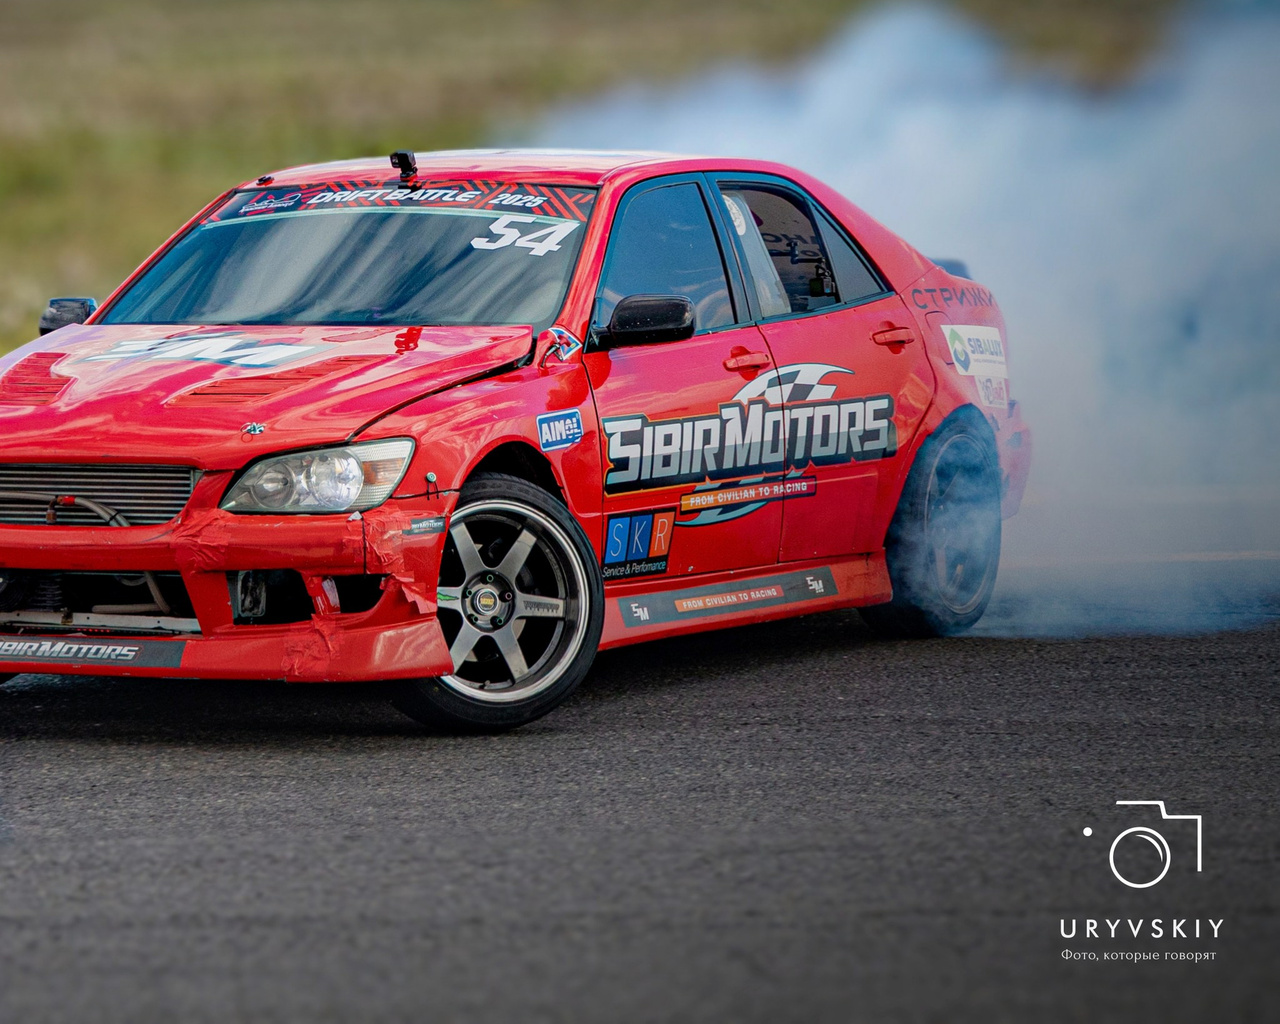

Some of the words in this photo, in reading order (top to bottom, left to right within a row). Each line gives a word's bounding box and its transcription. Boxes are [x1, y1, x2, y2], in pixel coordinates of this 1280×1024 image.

[306, 189, 389, 205] DRIFT
[383, 188, 481, 202] BATTLE
[488, 193, 548, 207] 2025
[470, 215, 581, 257] 54
[967, 337, 1004, 358] SIBALUX
[541, 417, 581, 444] AIMOL
[690, 494, 714, 507] FROM
[717, 489, 755, 502] CIVILIAN
[759, 487, 770, 497] TO
[773, 482, 808, 494] RACING
[609, 518, 669, 557] SKR
[602, 565, 625, 578] Service
[625, 564, 631, 576] &
[682, 598, 704, 609] FROM
[705, 592, 737, 606] CIVILIAN
[738, 591, 749, 601] TO
[750, 587, 777, 600] RACING
